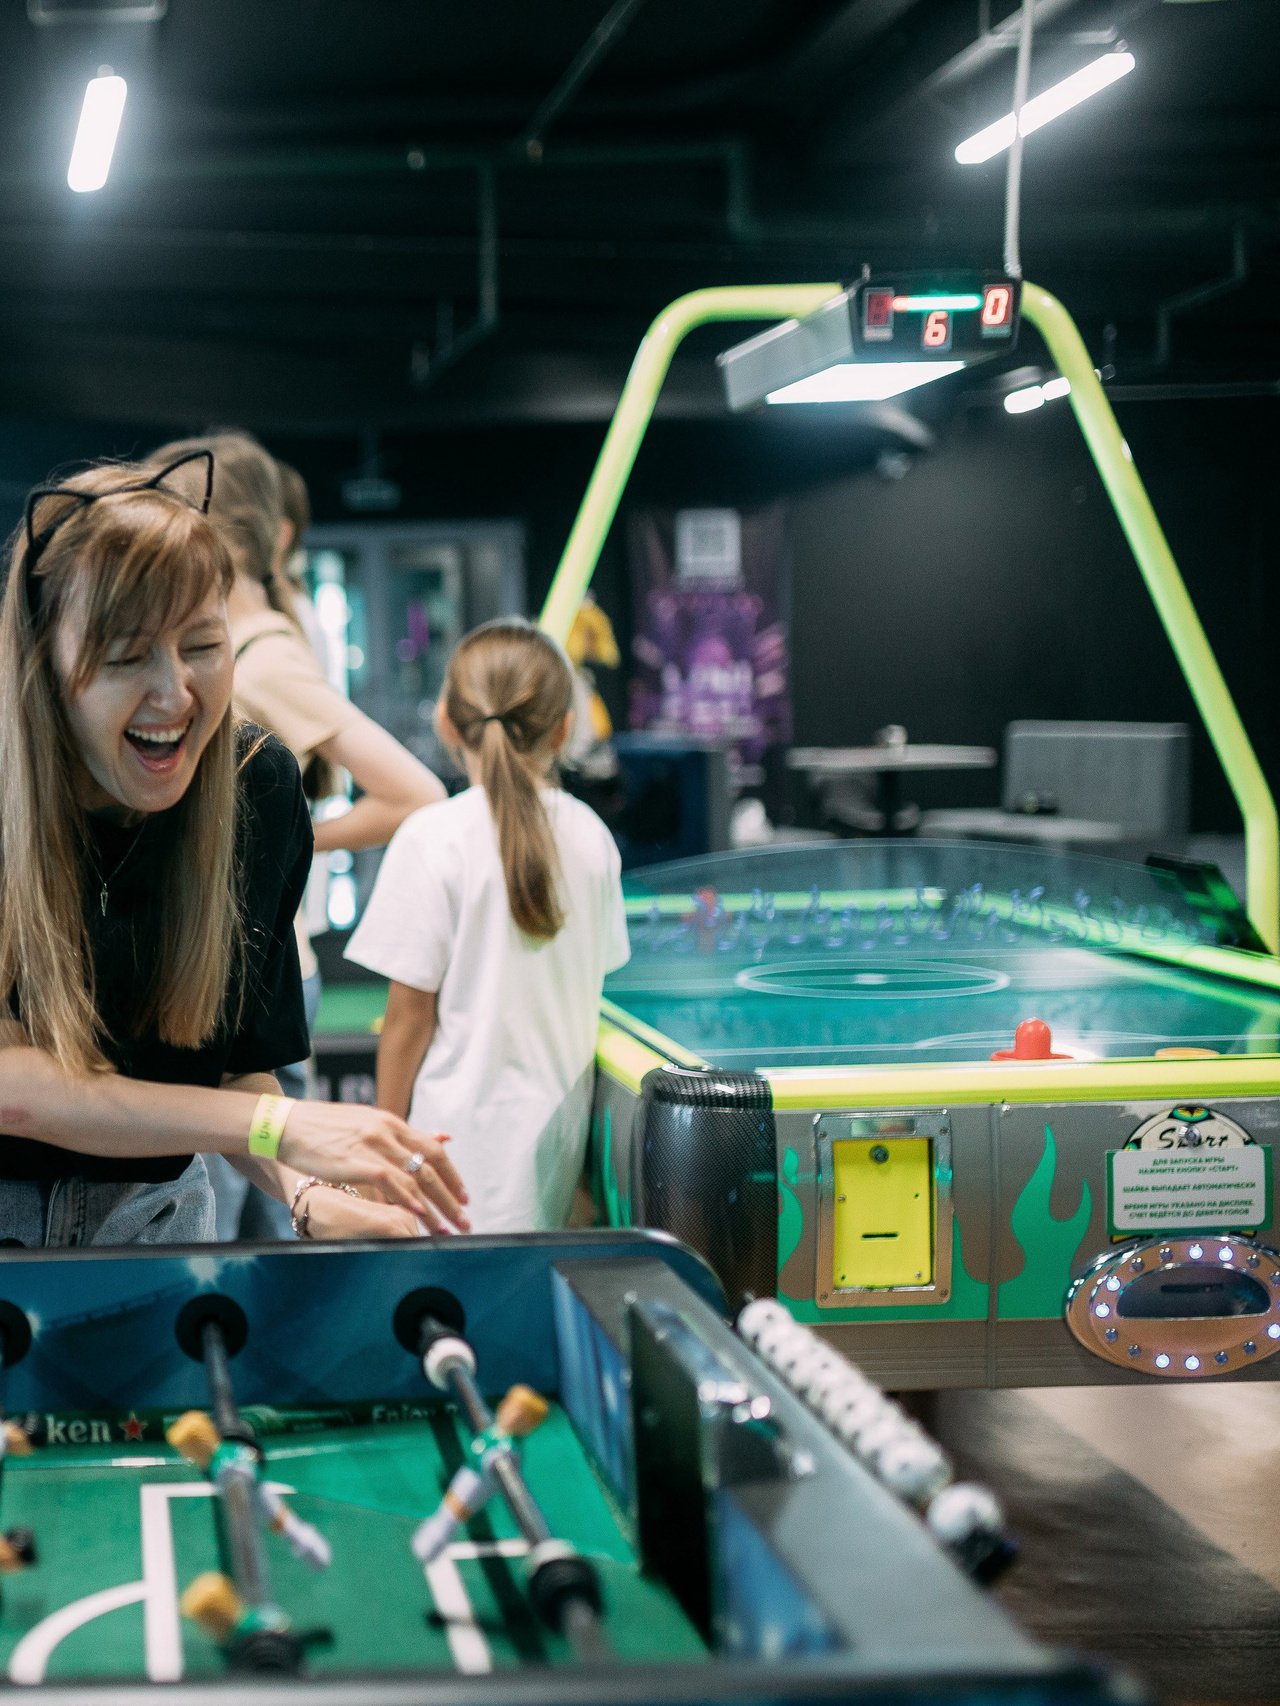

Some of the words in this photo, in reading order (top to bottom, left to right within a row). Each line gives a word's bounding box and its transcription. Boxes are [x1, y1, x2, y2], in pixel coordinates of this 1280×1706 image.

[982, 288, 1009, 325] 0
[923, 311, 948, 346] 6
[1157, 1126, 1229, 1149] Srt
